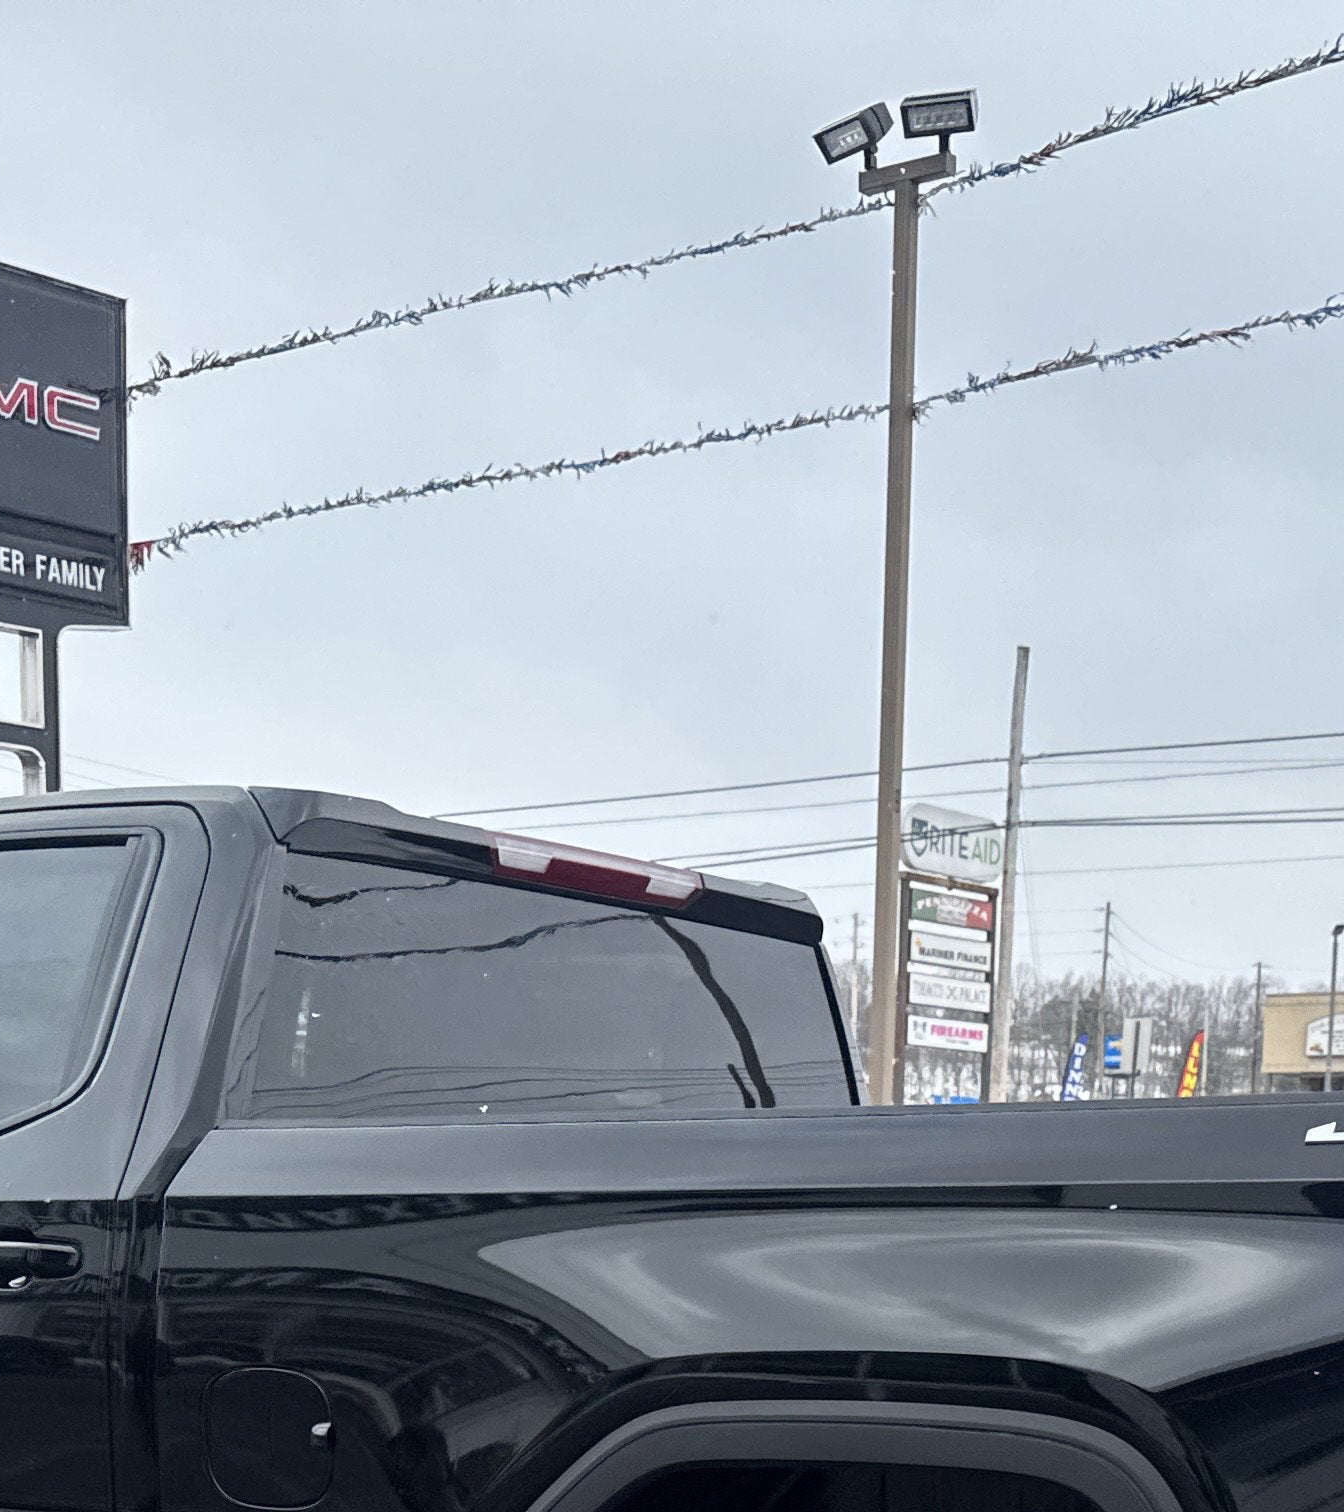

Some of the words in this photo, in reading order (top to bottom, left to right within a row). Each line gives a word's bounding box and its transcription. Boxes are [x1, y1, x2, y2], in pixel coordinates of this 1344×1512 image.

[35, 554, 106, 592] FAMILY
[929, 824, 969, 860] RITE
[971, 835, 1001, 865] AID
[930, 1024, 984, 1041] FIREARMS
[1063, 1042, 1087, 1101] DINN
